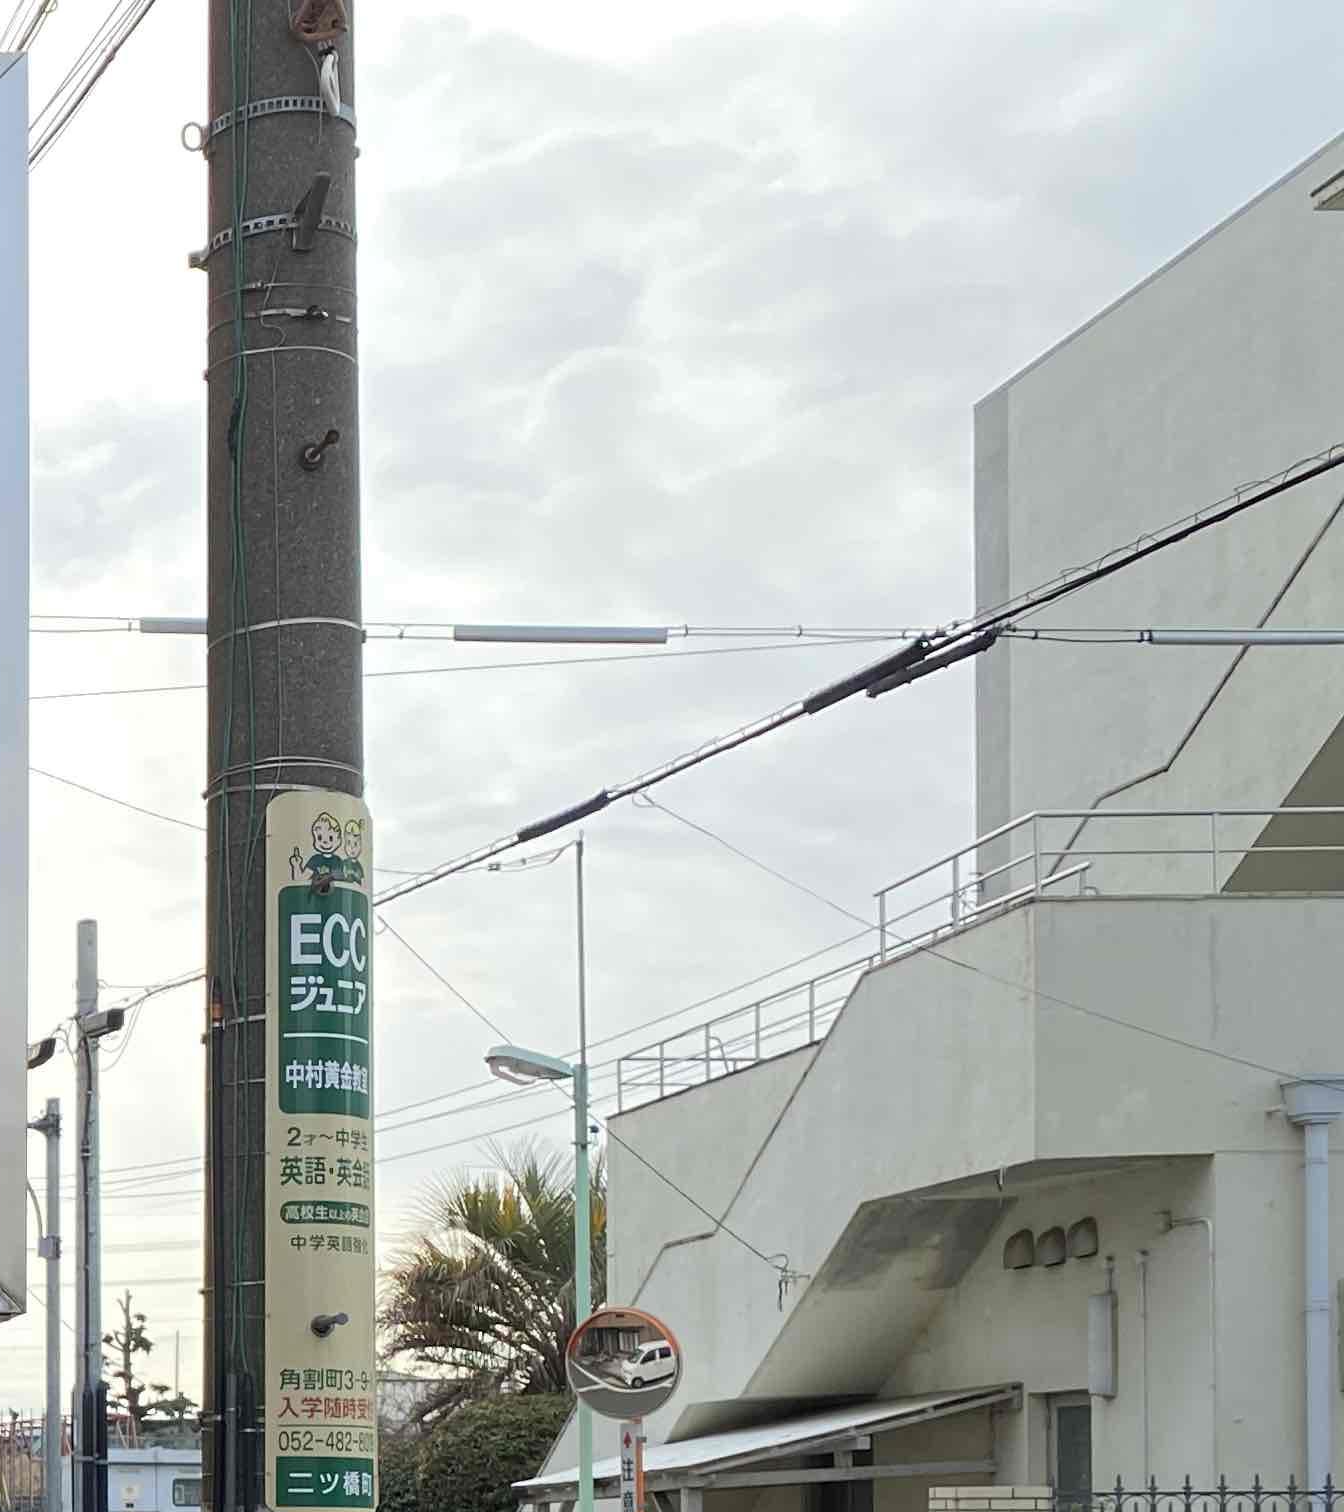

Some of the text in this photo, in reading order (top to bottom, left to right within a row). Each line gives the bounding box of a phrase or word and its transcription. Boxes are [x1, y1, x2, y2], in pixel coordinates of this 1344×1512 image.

[290, 912, 366, 972] ECC
[290, 975, 366, 1015] ジュニア
[287, 1471, 372, 1497] 二ツ橋町
